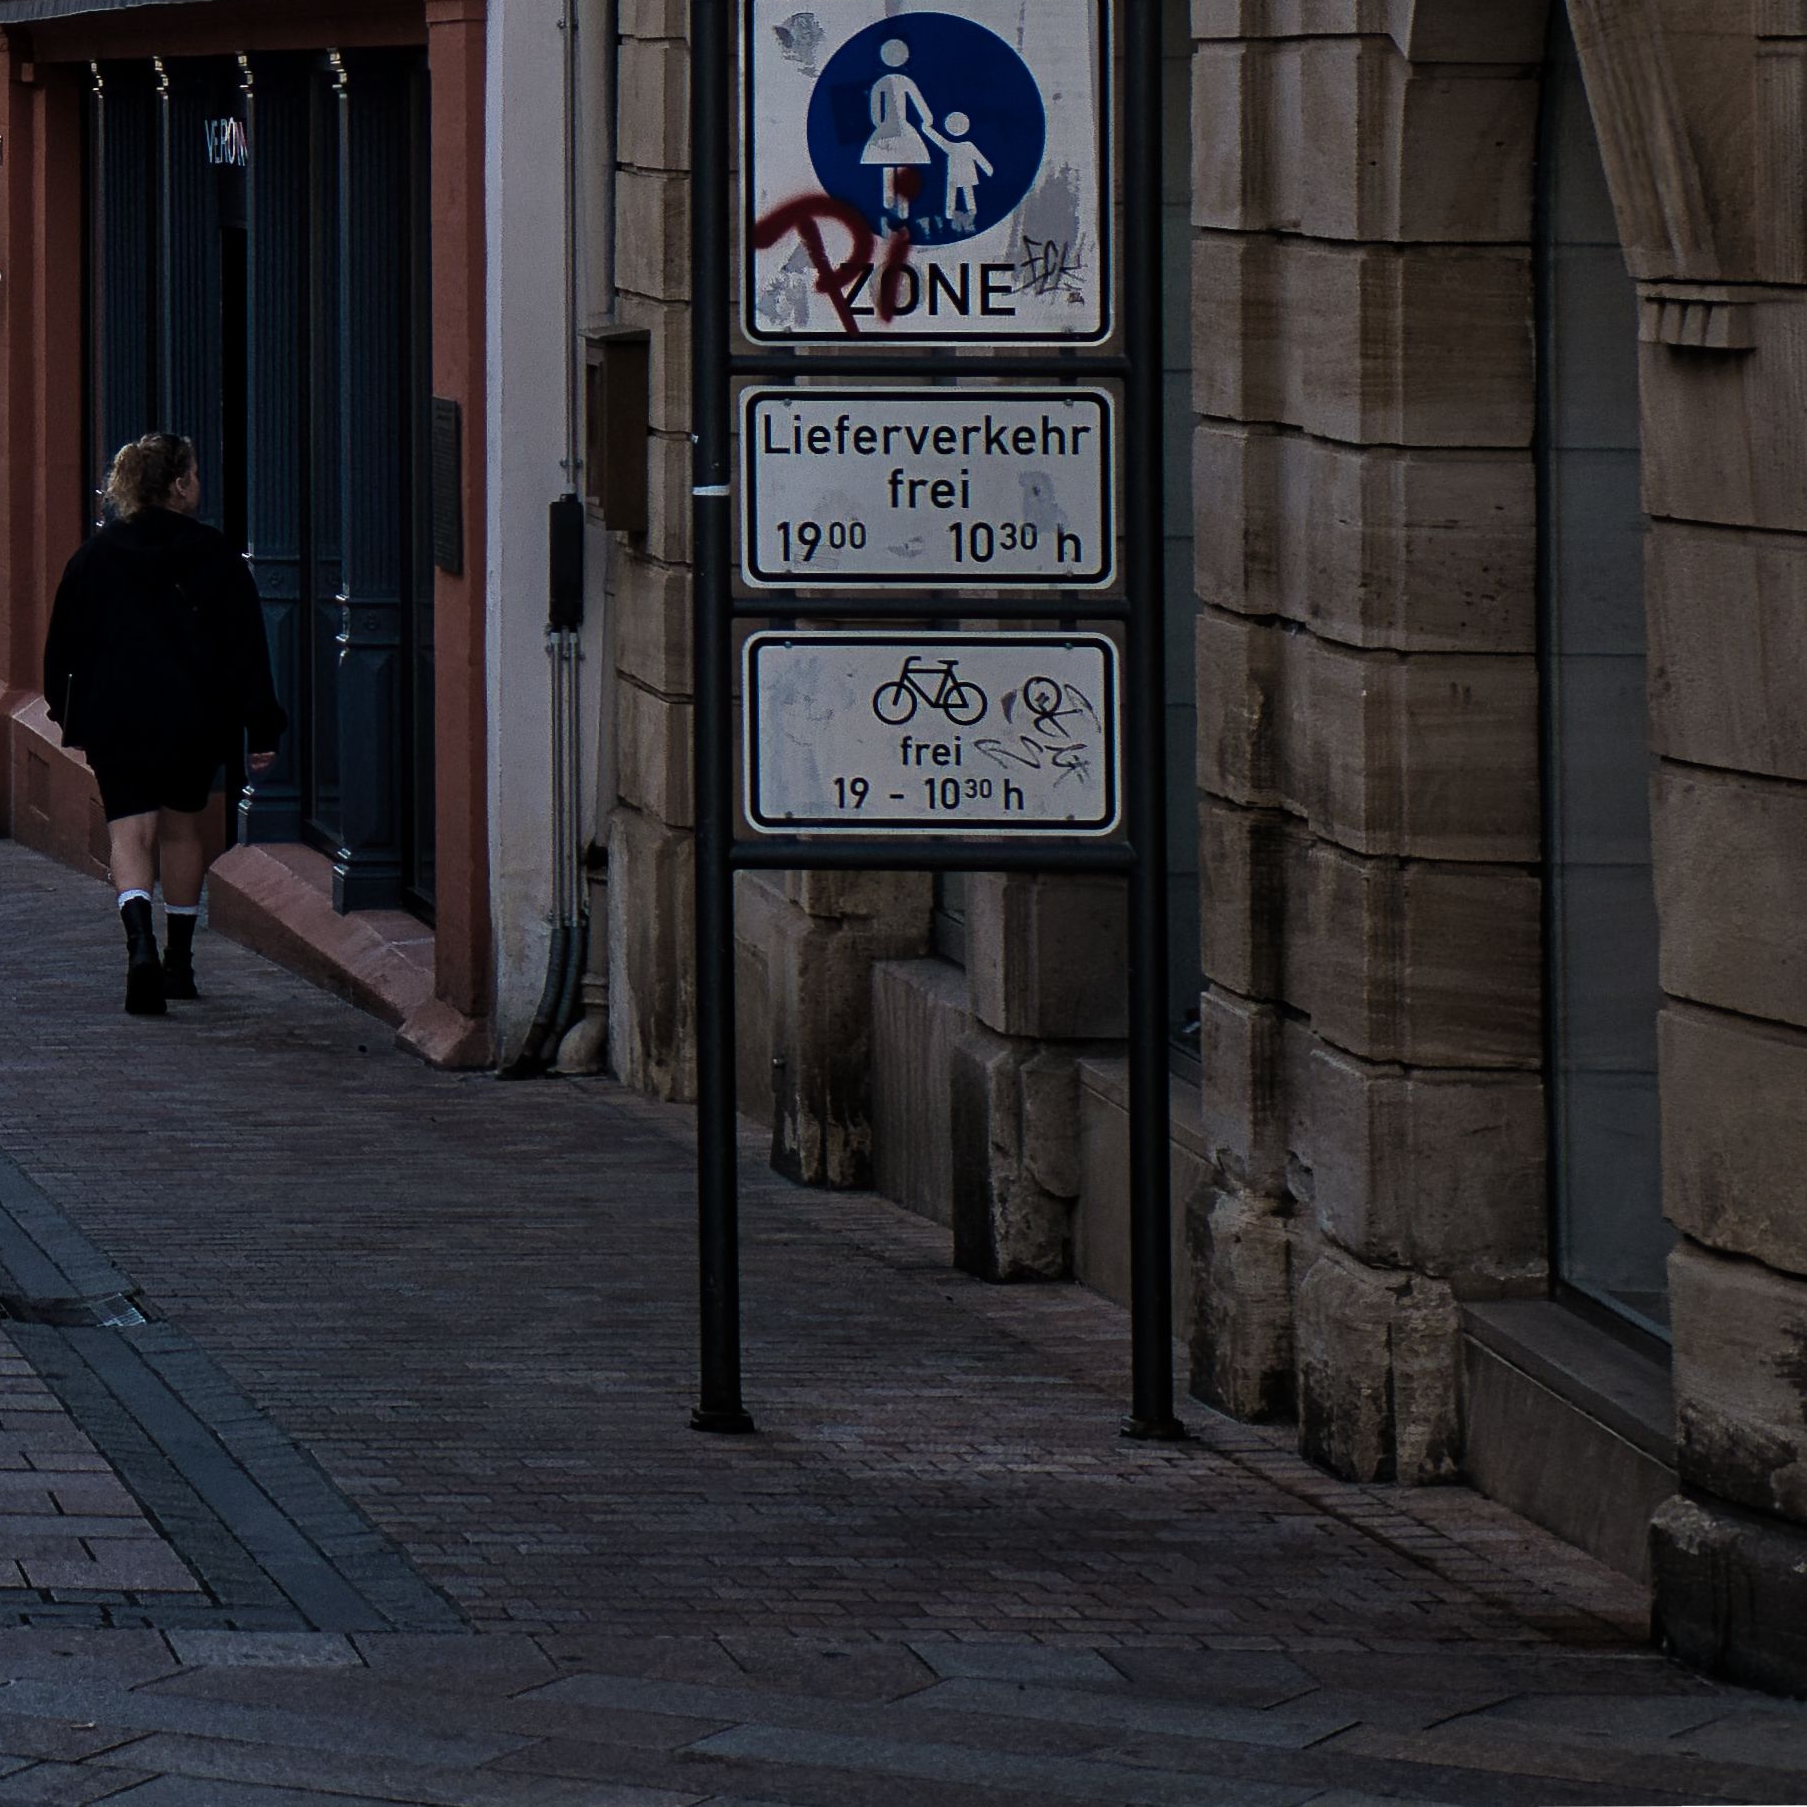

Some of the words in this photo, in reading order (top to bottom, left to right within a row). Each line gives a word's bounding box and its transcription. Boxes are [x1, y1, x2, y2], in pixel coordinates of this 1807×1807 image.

[840, 261, 1017, 317] ZONE
[763, 413, 1092, 455] Lieferverkehr
[887, 467, 971, 509] frei
[1056, 523, 1083, 563] h
[900, 734, 962, 767] frei
[834, 777, 870, 810] 19
[1003, 777, 1025, 811] h
